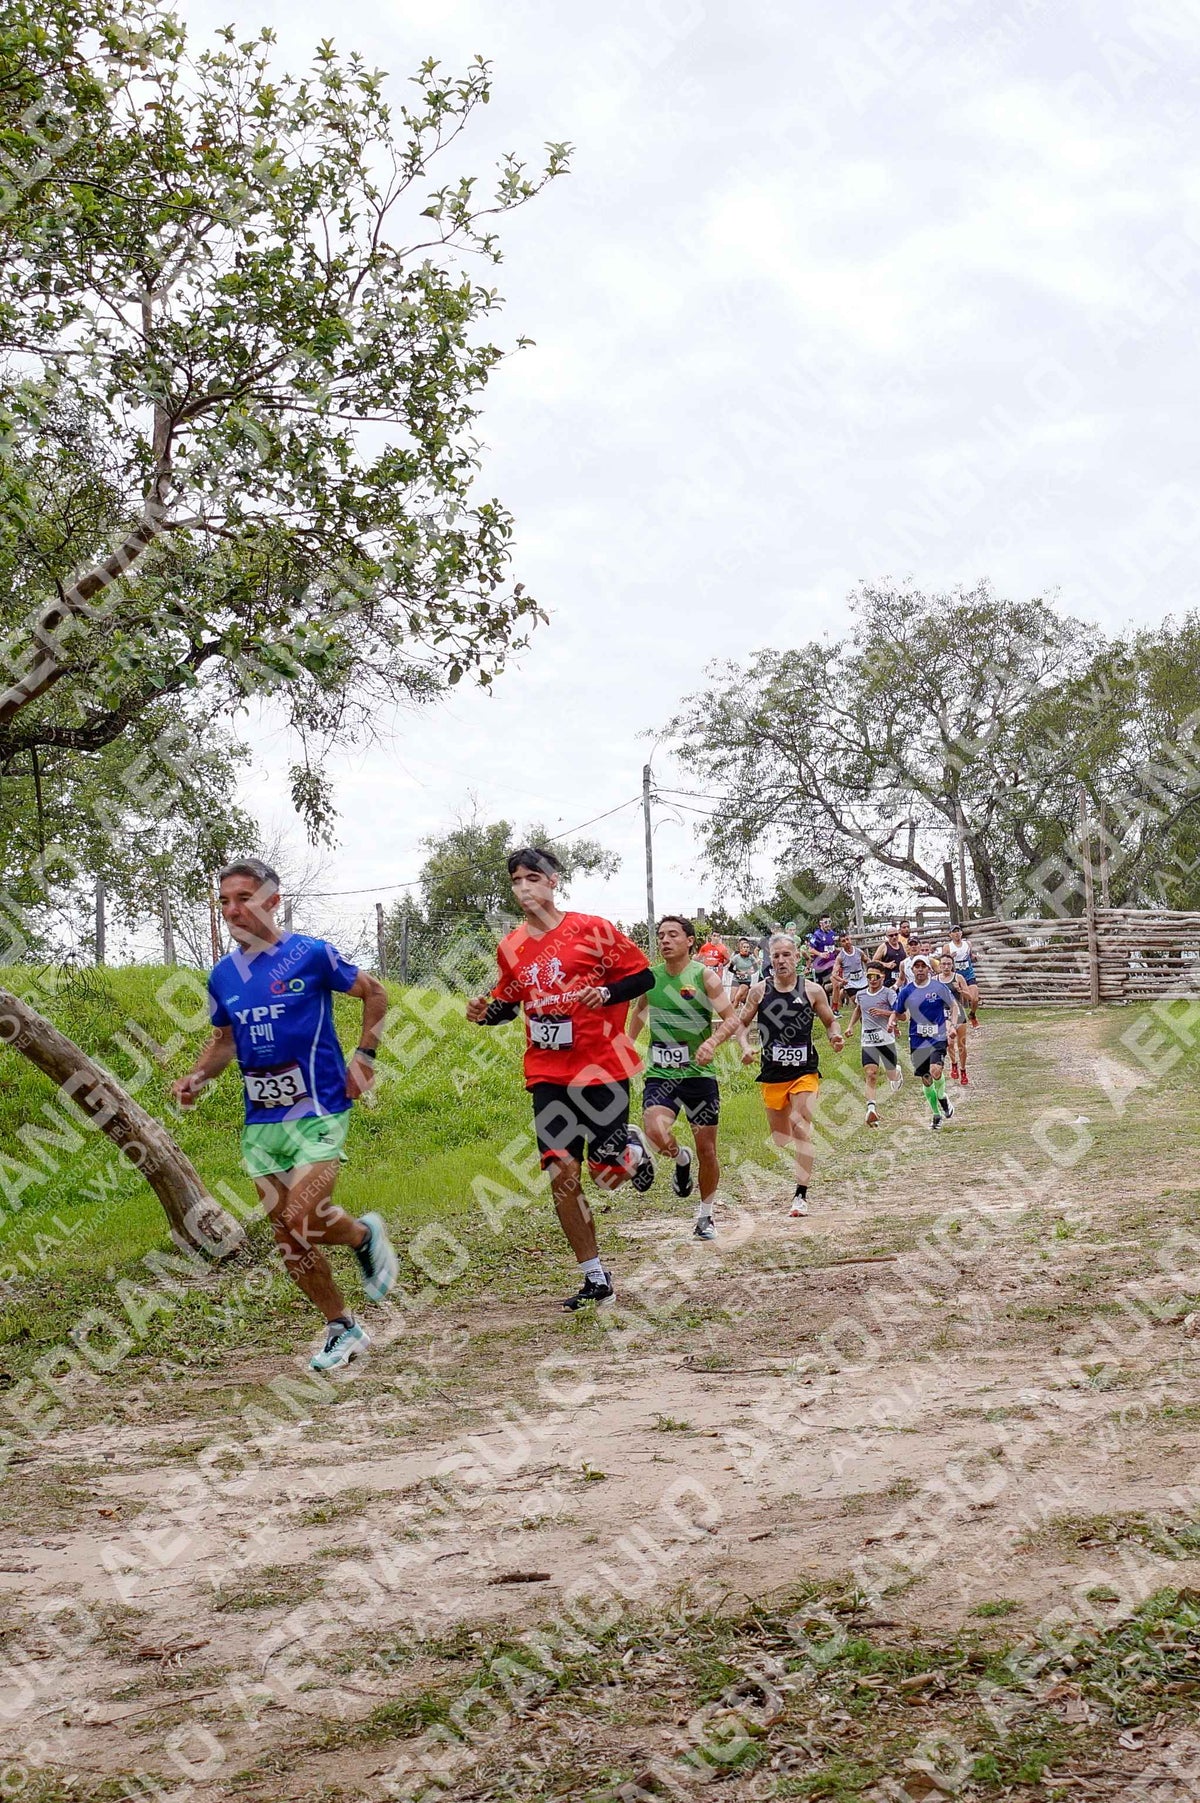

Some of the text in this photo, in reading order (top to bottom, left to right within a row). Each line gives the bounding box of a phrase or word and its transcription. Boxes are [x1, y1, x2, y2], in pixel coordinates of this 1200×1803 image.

[234, 1003, 286, 1025] YPF
[540, 1024, 560, 1043] 37
[922, 1026, 934, 1035] 58
[658, 1049, 682, 1063] 109
[778, 1049, 803, 1062] 259
[254, 1075, 298, 1100] 233
